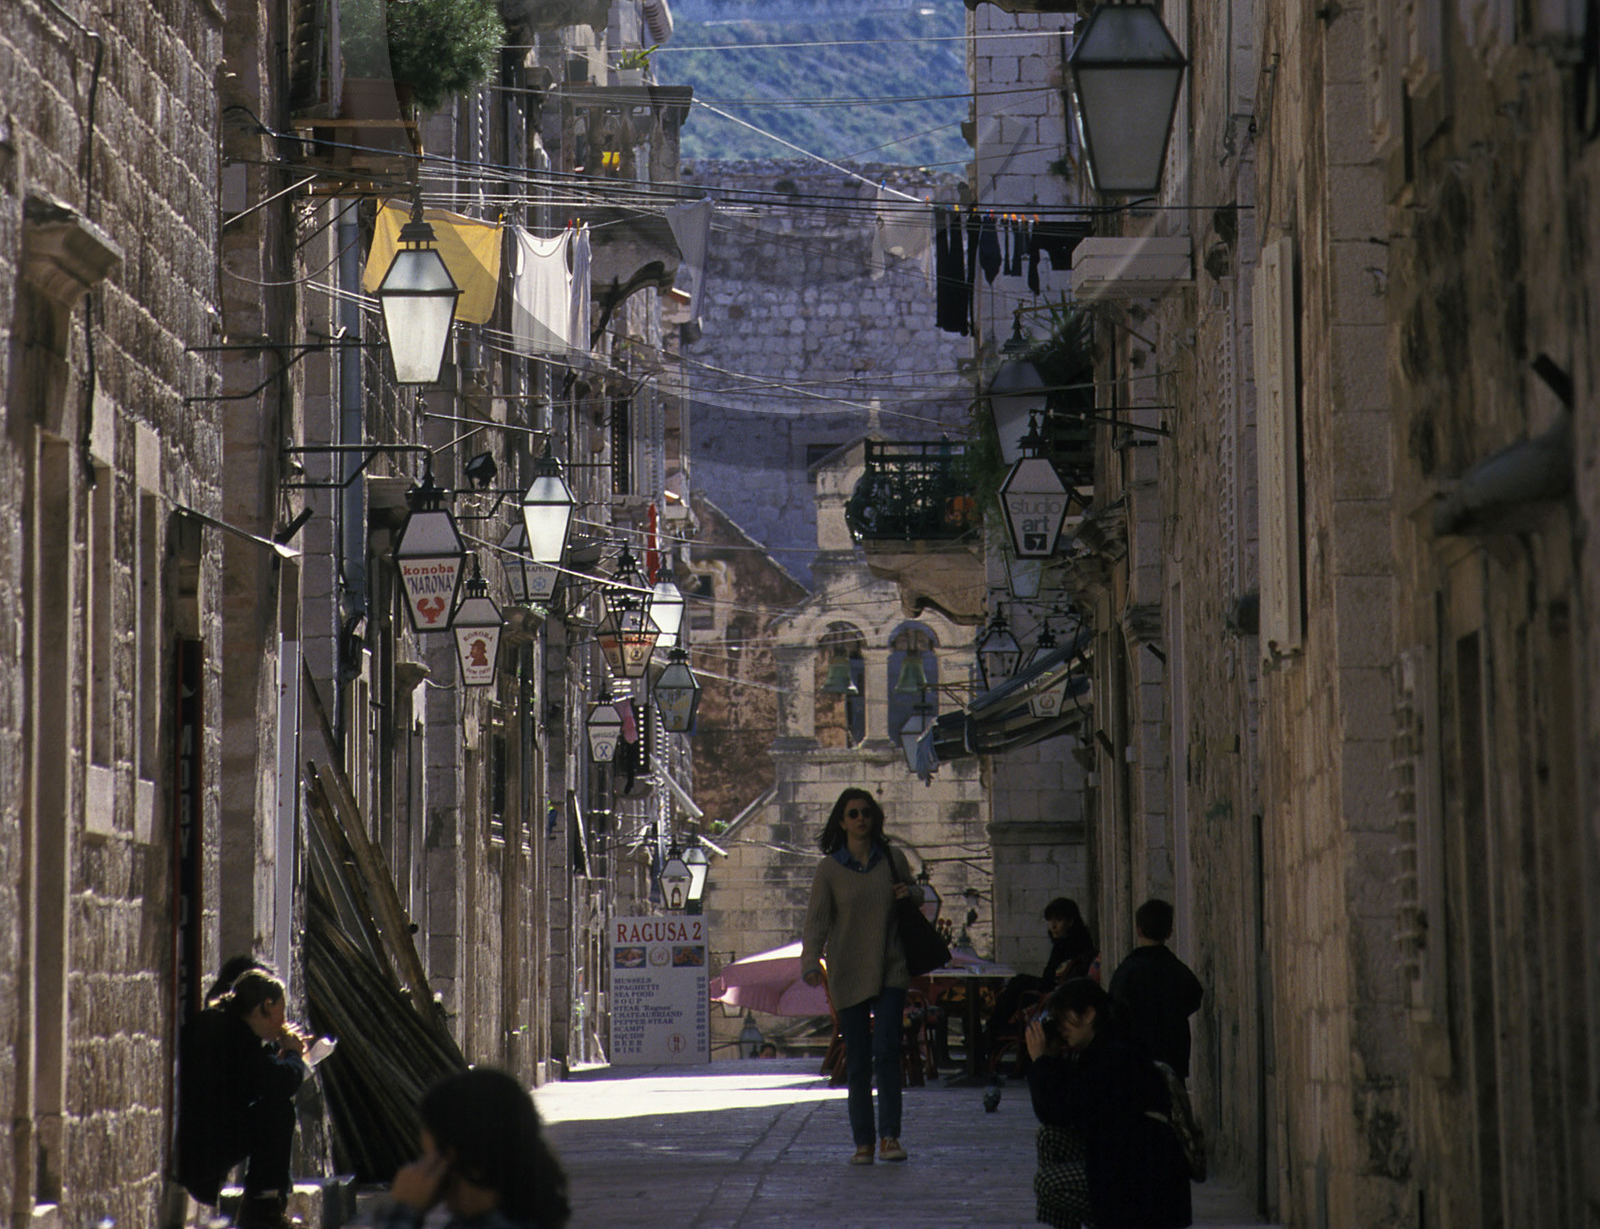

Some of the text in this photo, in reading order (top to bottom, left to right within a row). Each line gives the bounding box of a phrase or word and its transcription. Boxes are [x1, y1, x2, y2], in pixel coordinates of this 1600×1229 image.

[1011, 494, 1061, 515] studio
[1022, 516, 1050, 532] art
[403, 563, 454, 575] konoba
[463, 631, 494, 642] KONOBA
[617, 921, 702, 942] RAGUSA 2
